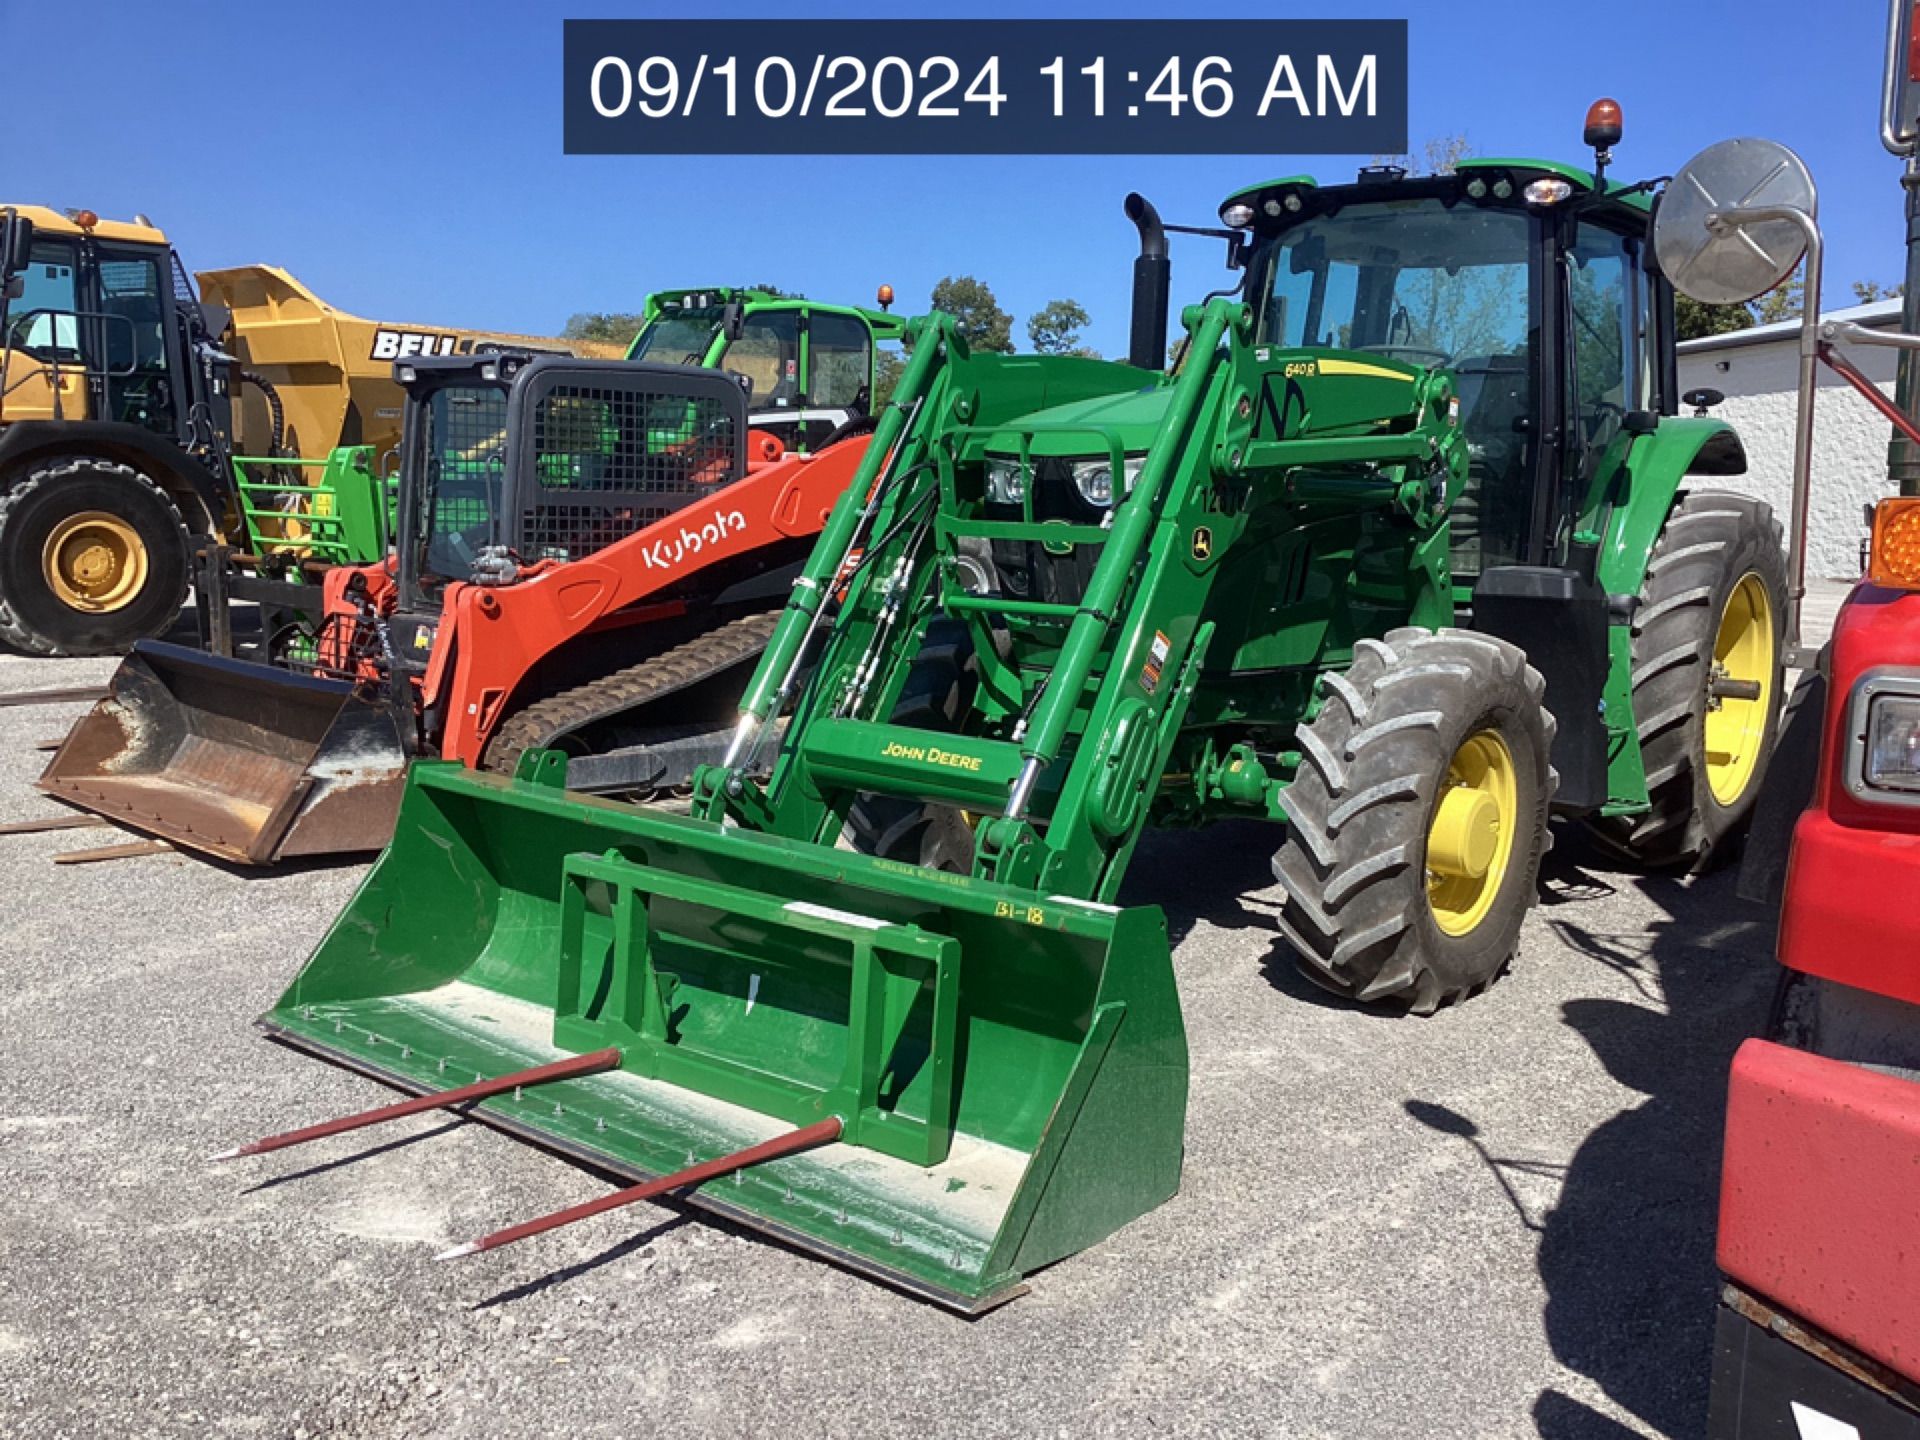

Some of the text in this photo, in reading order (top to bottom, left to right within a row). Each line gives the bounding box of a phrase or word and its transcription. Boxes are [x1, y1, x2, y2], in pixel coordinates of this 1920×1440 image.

[372, 331, 455, 359] BELL
[641, 509, 747, 569] Kubota
[881, 741, 982, 771] JOHN DEERE
